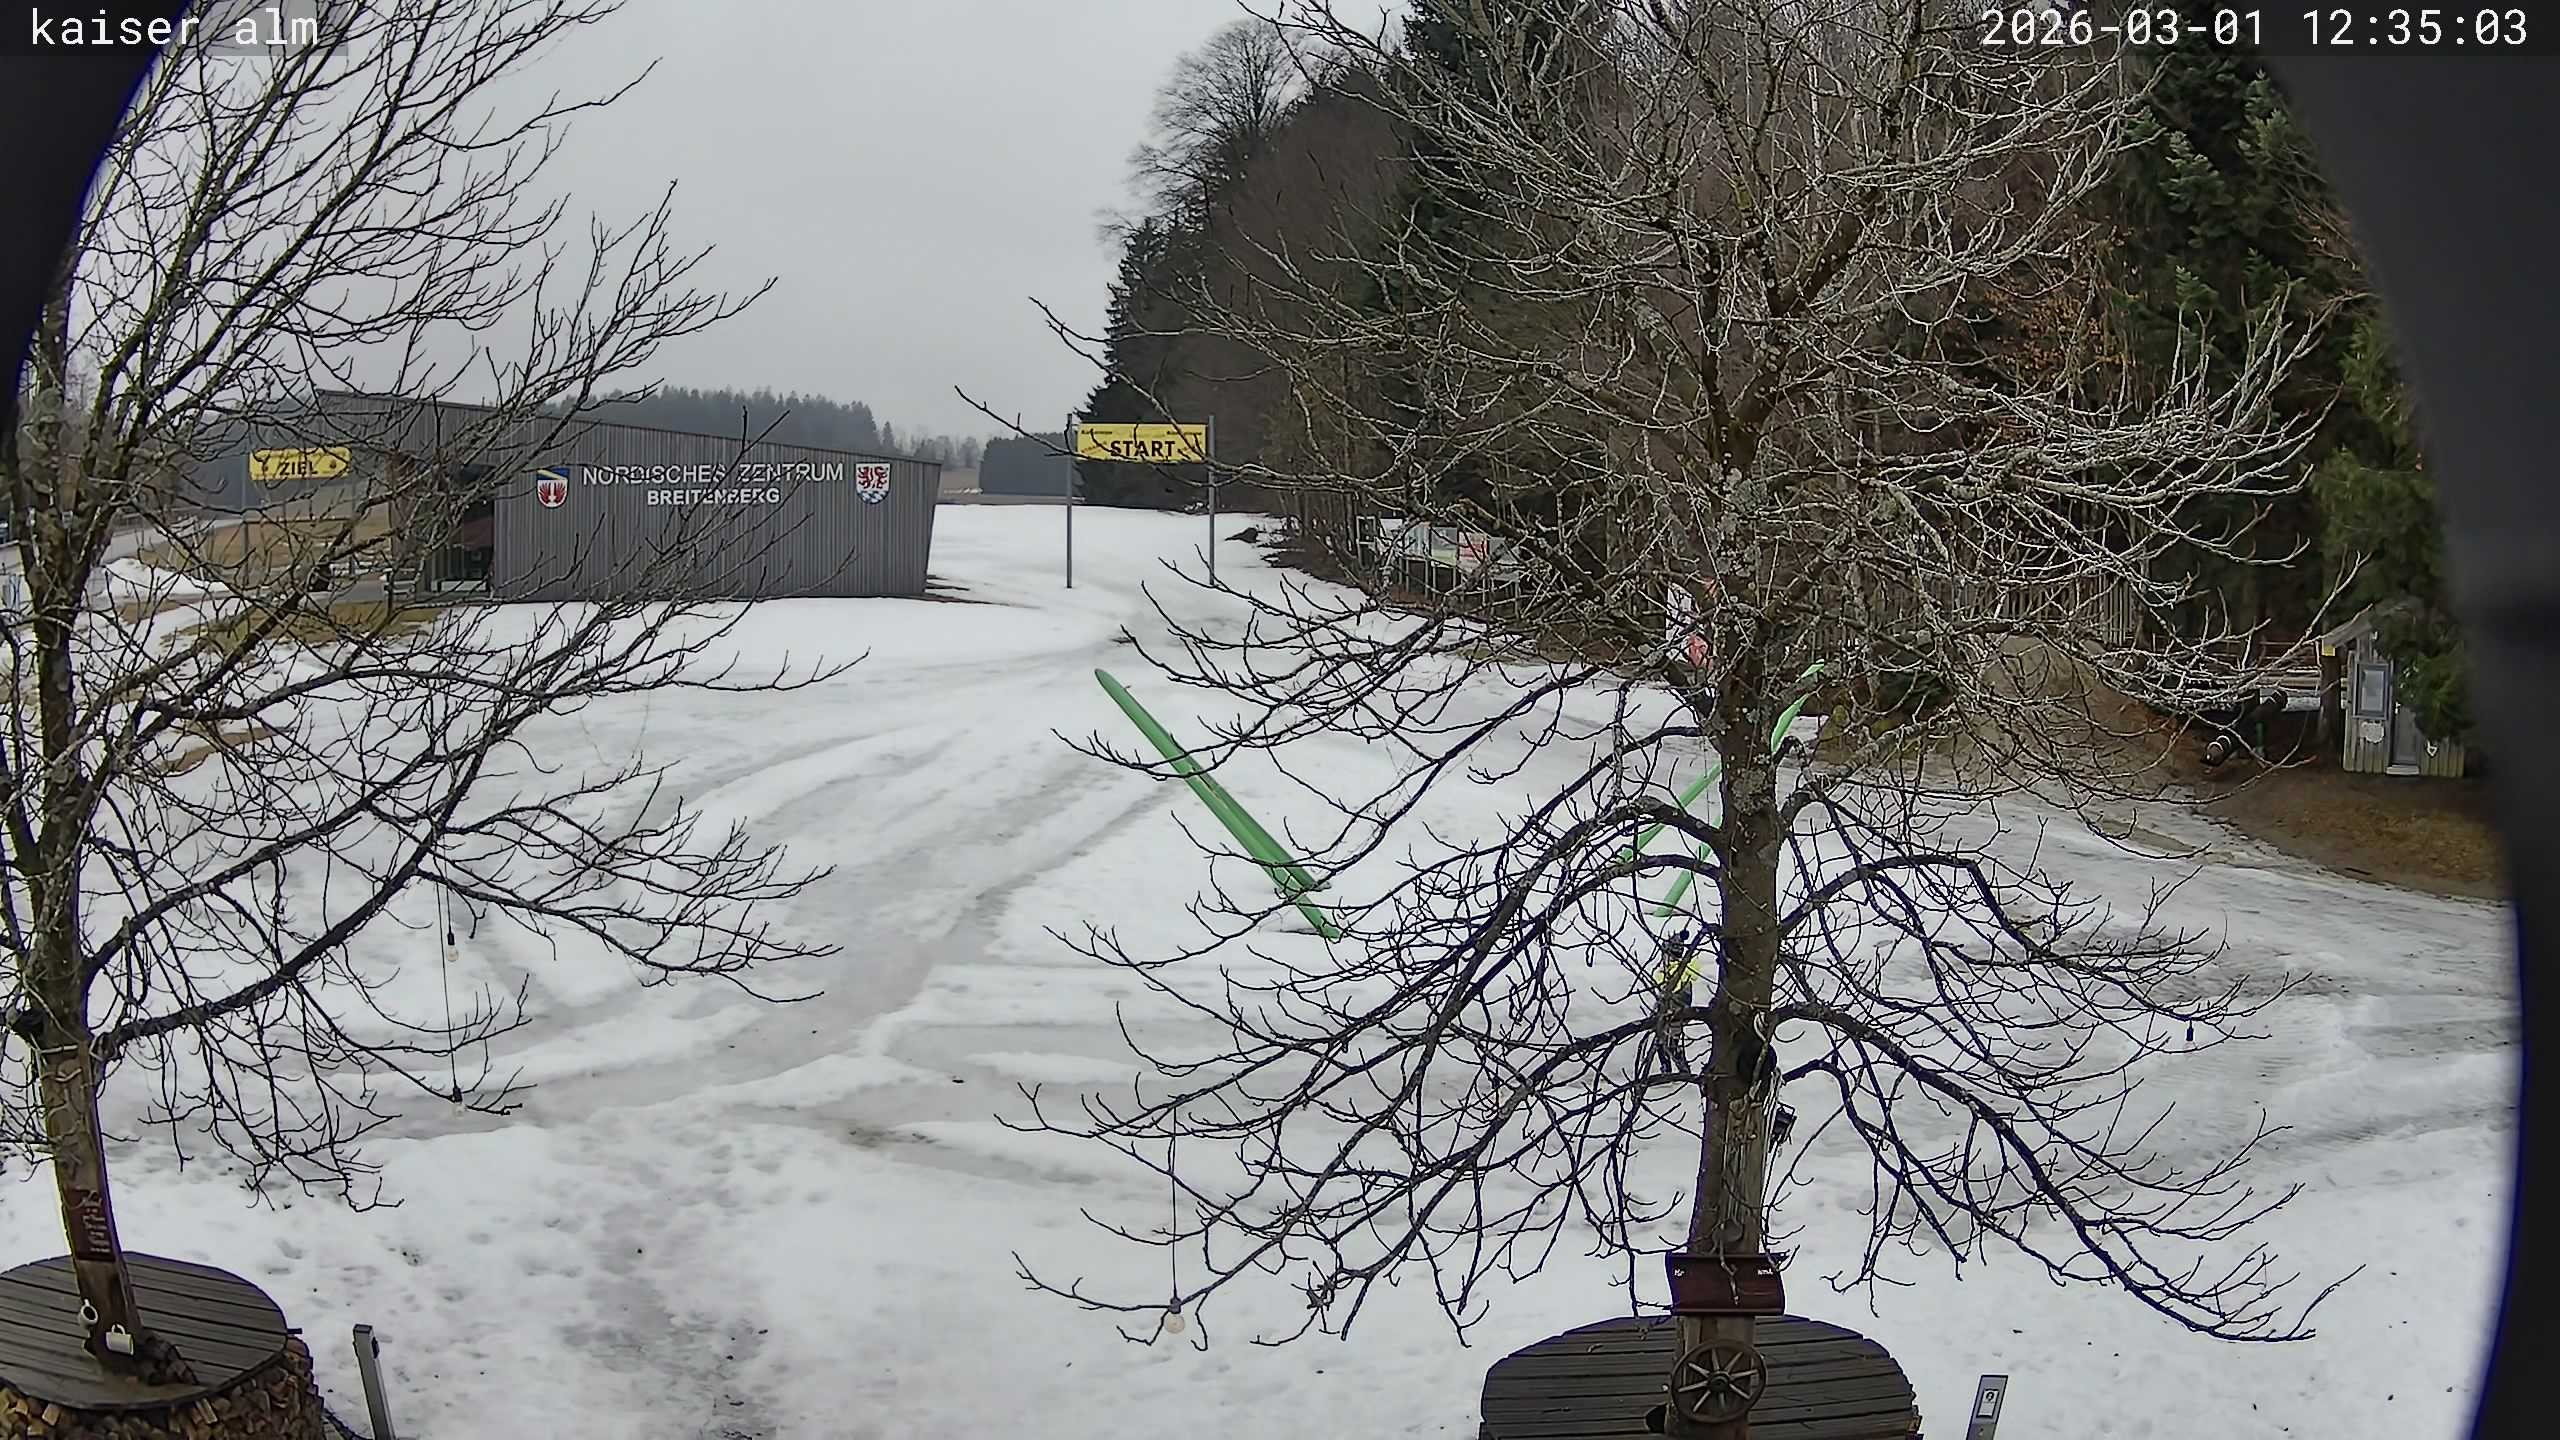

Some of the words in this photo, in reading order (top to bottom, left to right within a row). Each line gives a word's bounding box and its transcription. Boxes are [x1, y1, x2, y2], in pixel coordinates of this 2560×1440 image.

[1110, 440, 1176, 457] START
[279, 461, 319, 476] ZIEL
[583, 464, 727, 485] NORDISCHES
[737, 463, 844, 482] ZENTRUM
[647, 488, 780, 505] BREITENBERG
